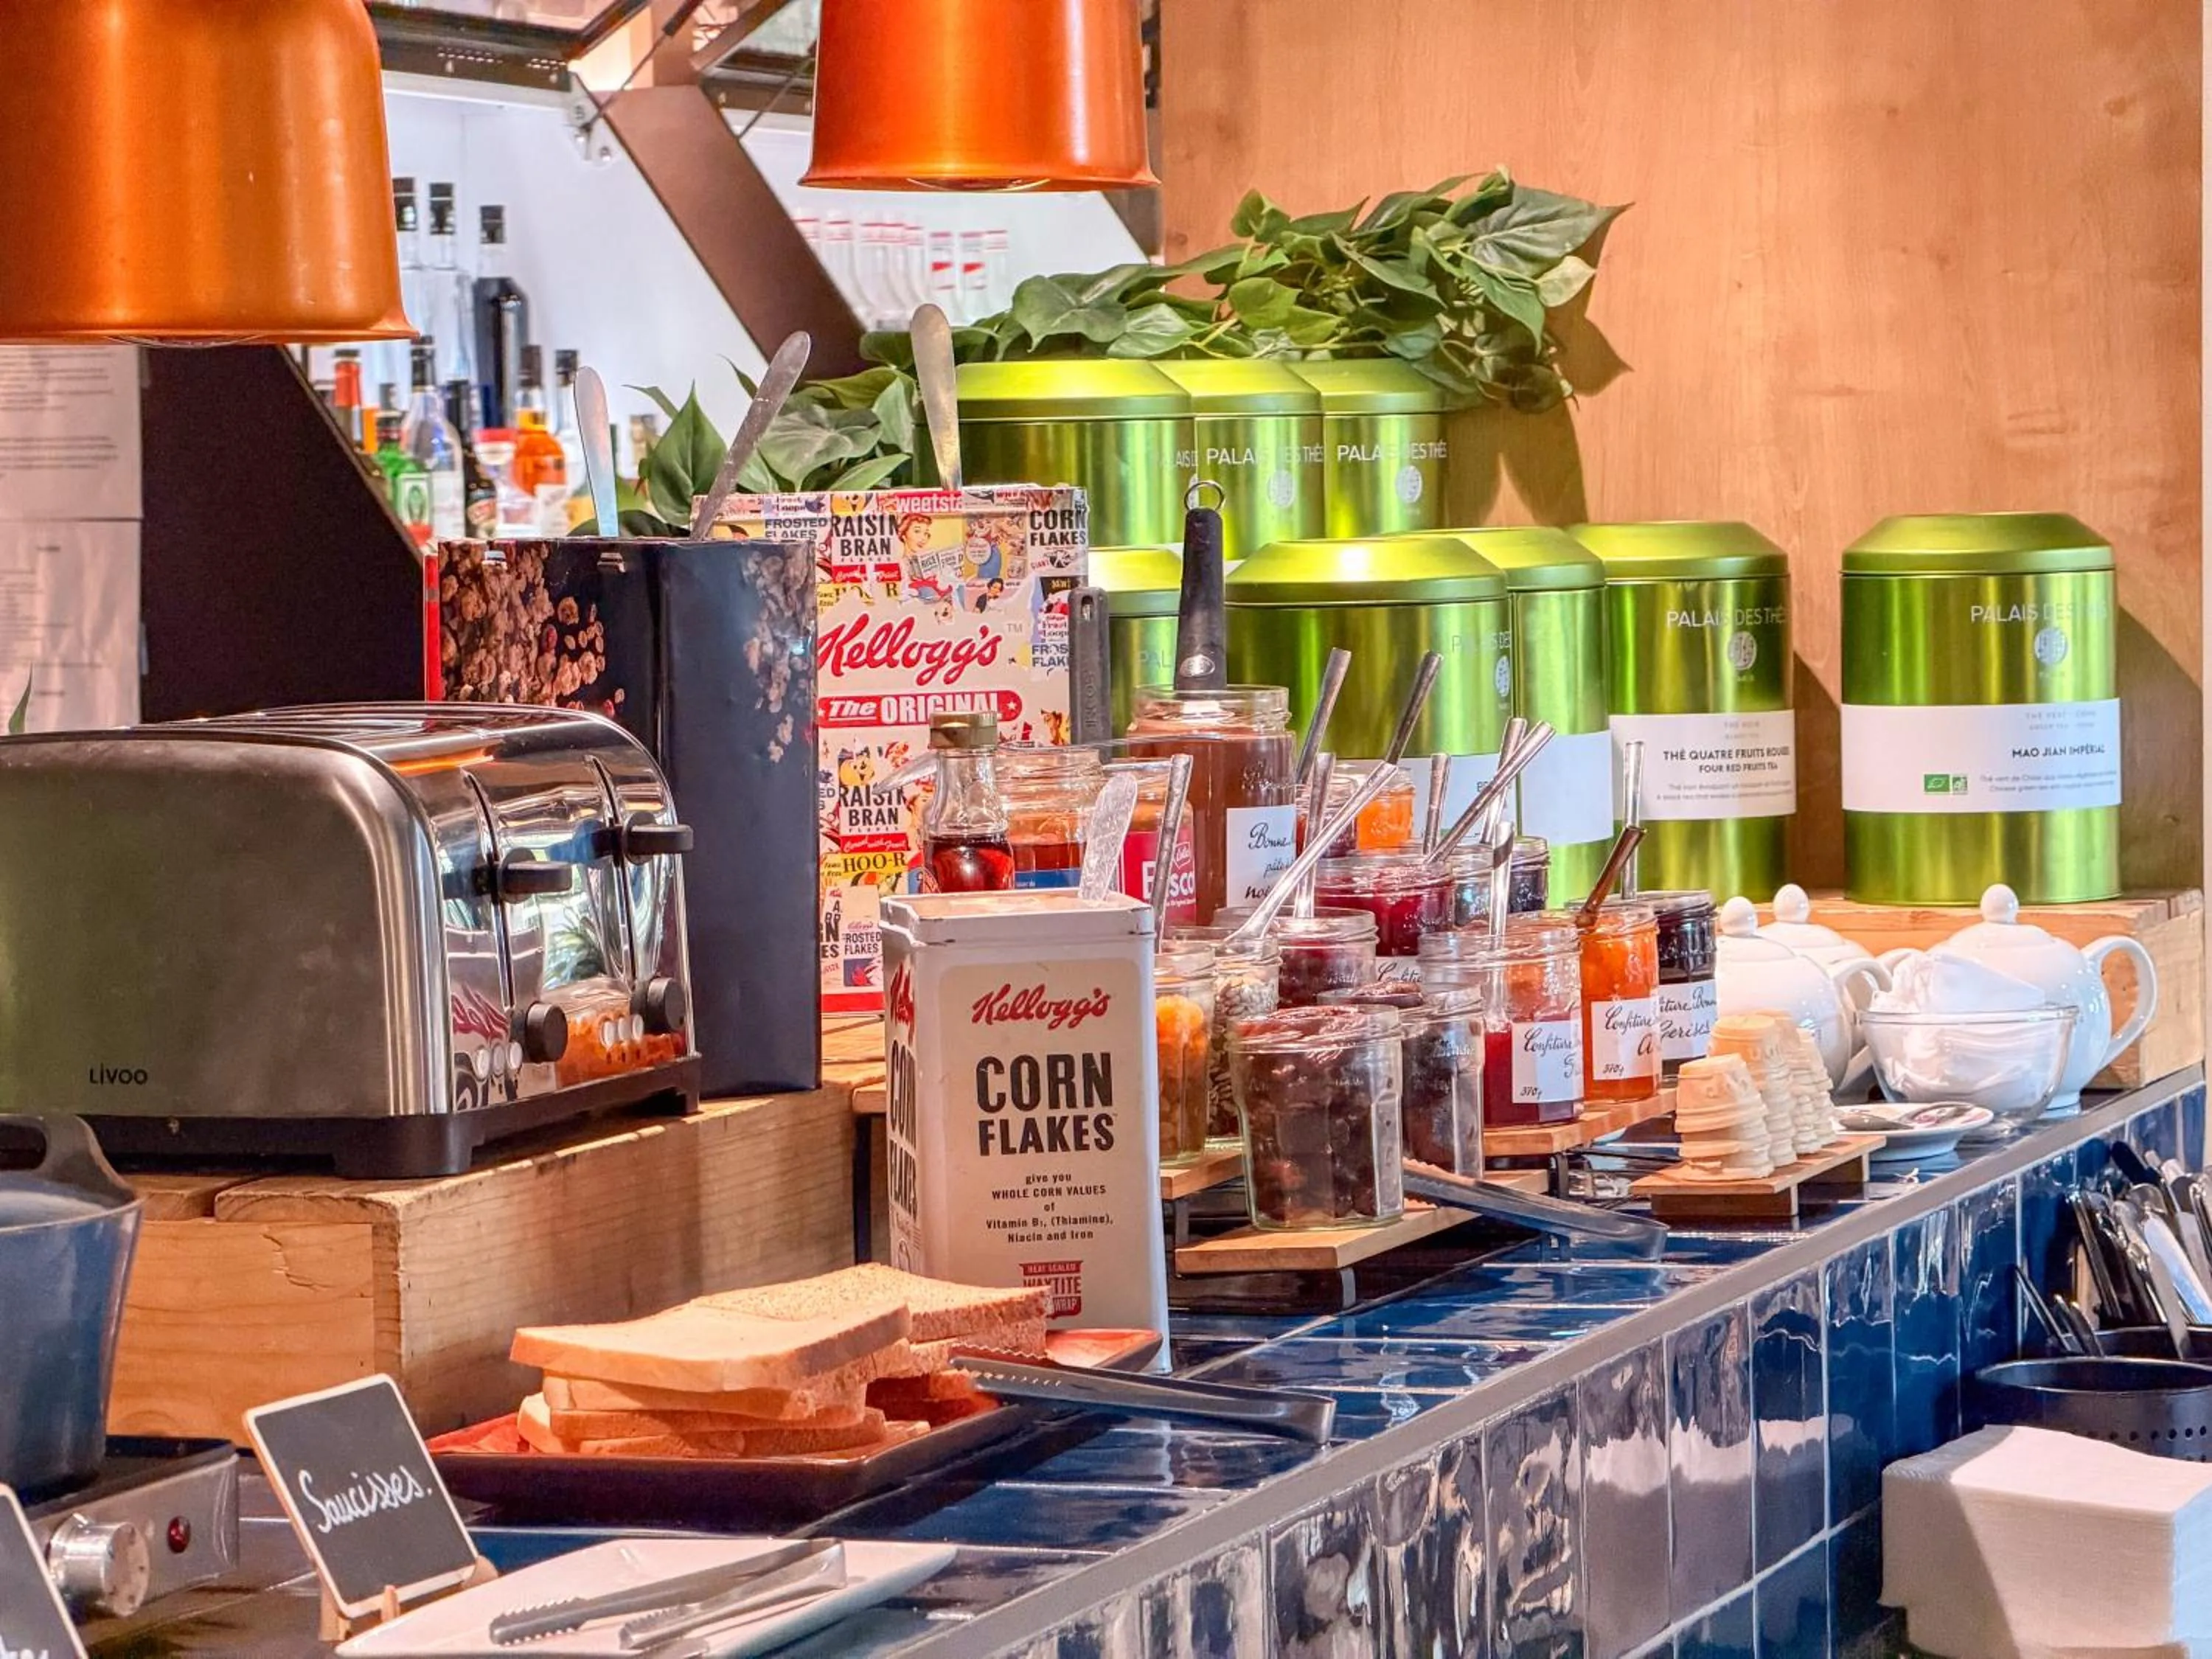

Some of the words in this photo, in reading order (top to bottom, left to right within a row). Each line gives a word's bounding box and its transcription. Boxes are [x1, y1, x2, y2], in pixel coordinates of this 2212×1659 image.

[765, 518, 828, 529] FROSTED
[831, 514, 899, 538] RAISIN
[1030, 509, 1087, 530] CORN
[1030, 530, 1087, 546] FLAKES
[841, 538, 891, 557] BRAN
[1735, 608, 1763, 626] DES
[1970, 603, 2038, 622] PALAIS
[818, 613, 1002, 686] Kellogg's
[1032, 644, 1069, 655] FROS
[1032, 656, 1069, 667] FLAK
[829, 700, 878, 717] The
[1663, 746, 1686, 760] THÉ
[1688, 749, 1733, 760] QUATRE
[1735, 748, 1765, 759] FRUITS
[2012, 747, 2039, 758] MAO
[2042, 746, 2067, 757] JIAN
[1699, 764, 1724, 773] FOUR
[1726, 763, 1742, 773] RED
[1743, 762, 1767, 772] FRUITS
[849, 807, 899, 827] BRAN
[844, 943, 880, 955] FLAKES
[971, 983, 1111, 1030] Kellogg's
[1605, 1005, 1655, 1032] Confiture
[1523, 1027, 1573, 1057] Confiture
[975, 1051, 1113, 1114] CORN
[978, 1113, 1114, 1157] FLAKES
[1026, 1174, 1048, 1185] give
[1052, 1173, 1072, 1184] you
[992, 1188, 1030, 1200] WHOLE
[1033, 1187, 1062, 1198] CORN
[1066, 1185, 1107, 1196] VALUES
[1043, 1202, 1055, 1212] of
[986, 1217, 1028, 1229] Vitamin
[1008, 1231, 1043, 1243] Niacin
[1046, 1231, 1067, 1241] and
[1071, 1230, 1093, 1239] Iron
[299, 1464, 433, 1533] Saucisses.
